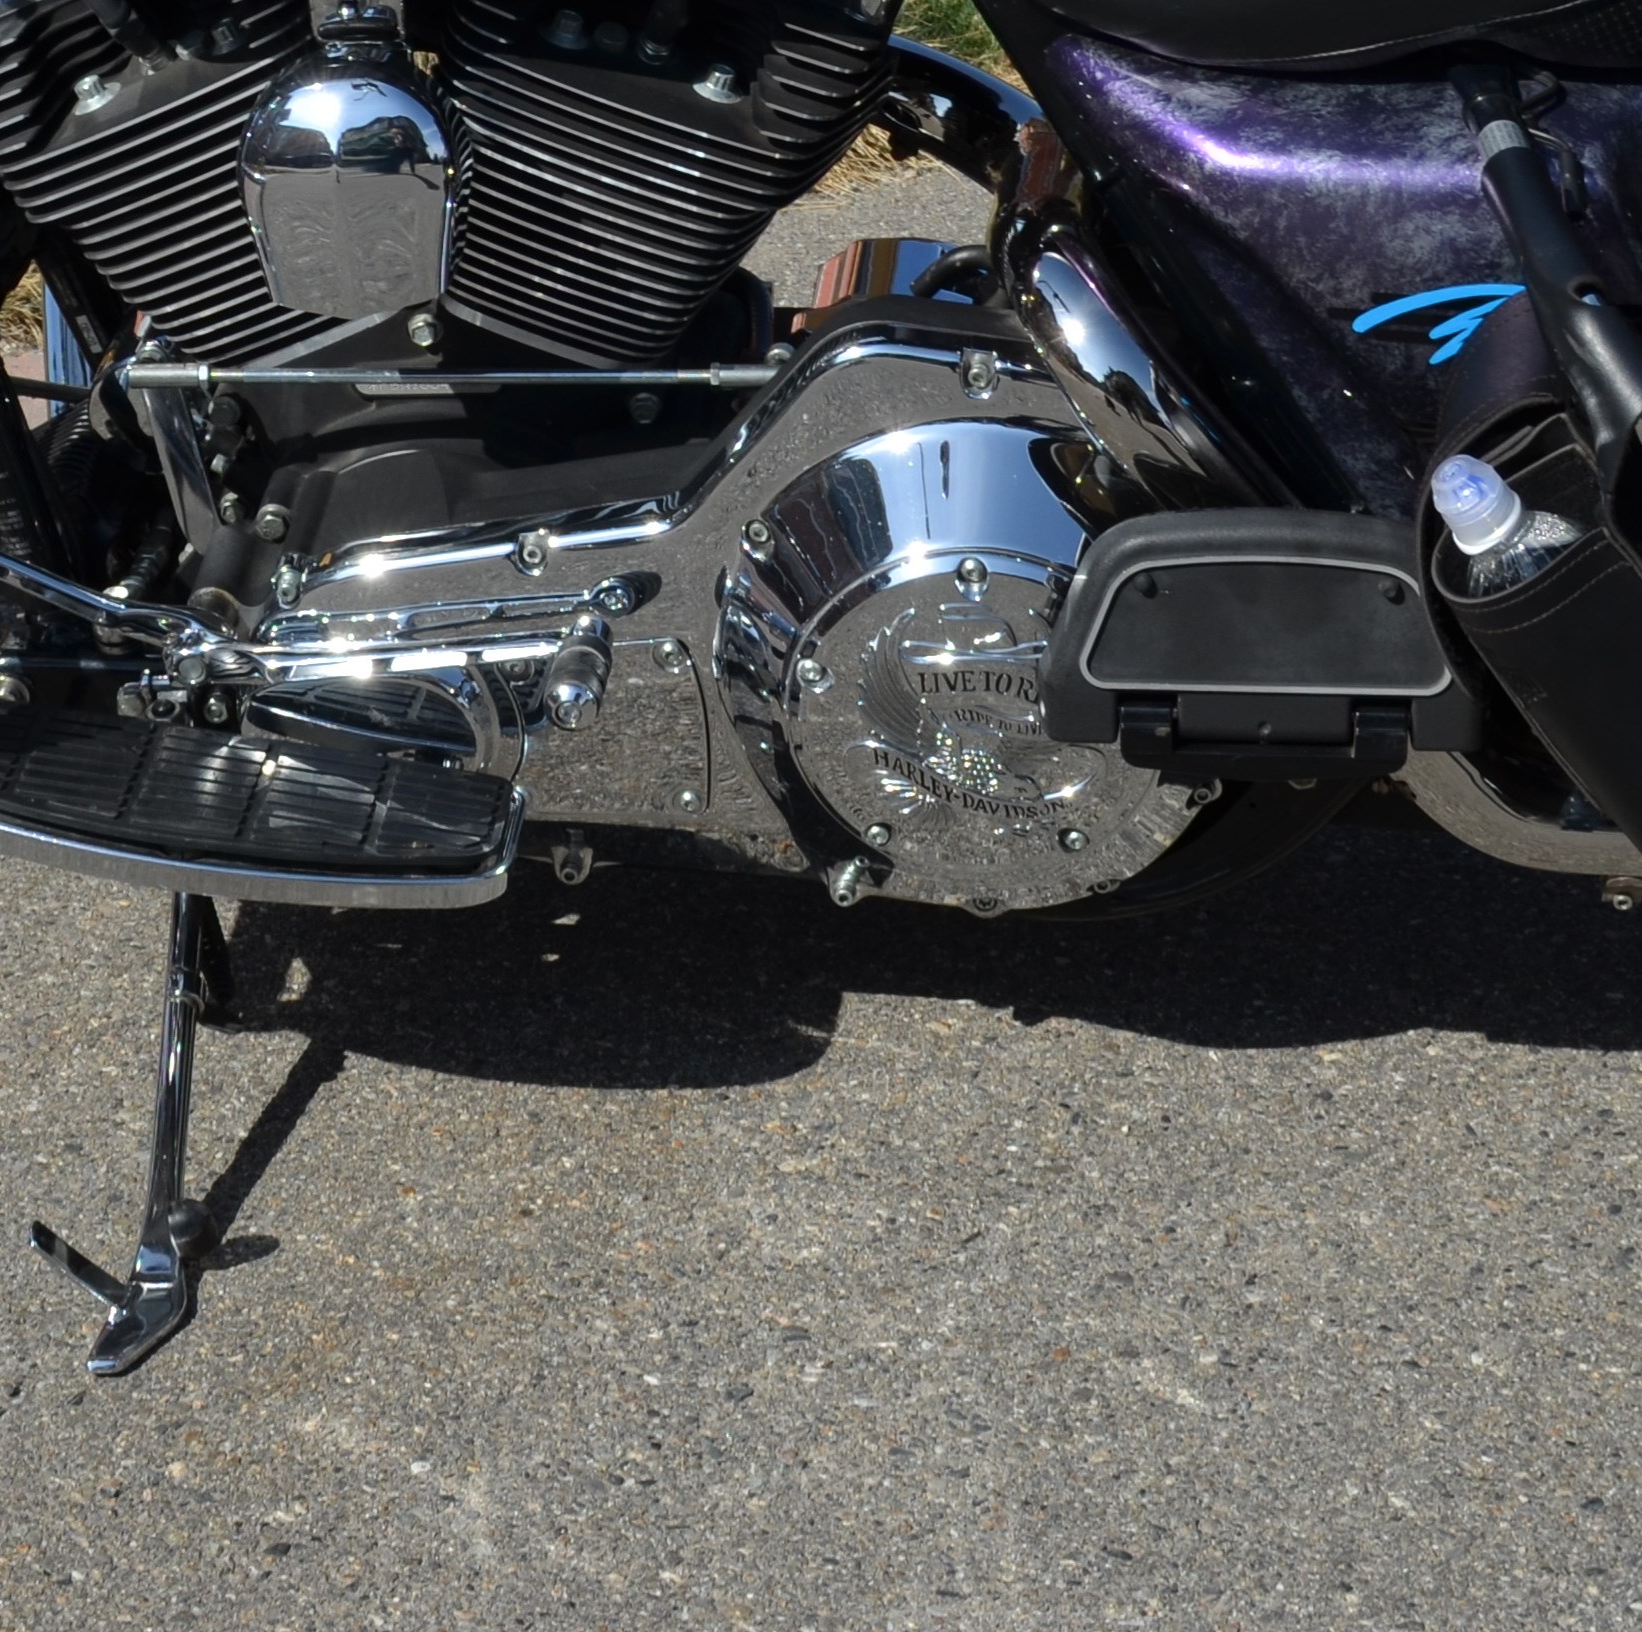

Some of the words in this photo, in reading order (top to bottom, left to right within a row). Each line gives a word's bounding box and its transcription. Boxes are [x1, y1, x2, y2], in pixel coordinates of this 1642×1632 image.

[917, 670, 976, 695] LIVE
[981, 671, 1012, 695] TO
[872, 748, 1064, 820] HARLEY-DAVIDSON
